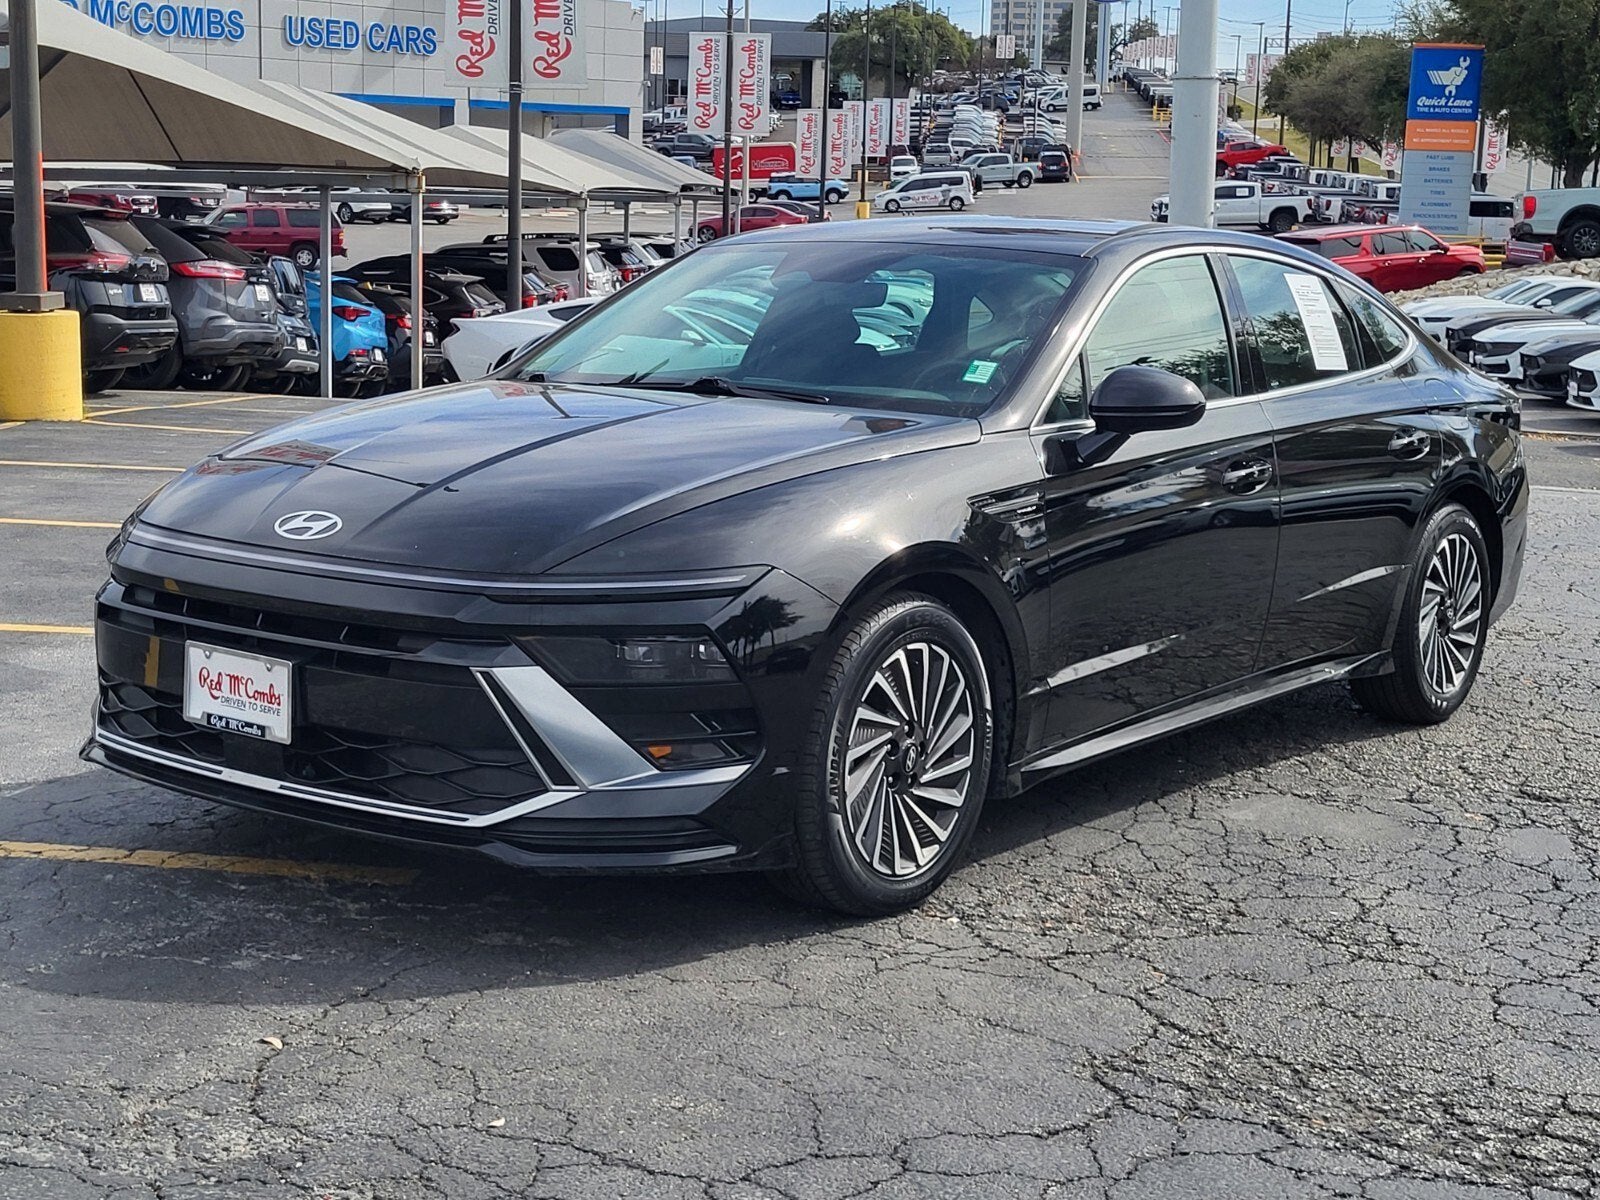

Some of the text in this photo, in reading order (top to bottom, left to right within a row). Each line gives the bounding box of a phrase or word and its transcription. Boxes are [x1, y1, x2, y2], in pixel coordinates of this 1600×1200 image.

[287, 15, 438, 56] USED CARS
[456, 29, 496, 78] Red
[533, 30, 572, 79] Red
[694, 38, 717, 129] Red McCombs
[713, 63, 720, 74] TO
[738, 39, 761, 130] Red McCombs
[757, 64, 764, 76] TO
[869, 104, 879, 137] McCombs
[1416, 96, 1473, 107] Quick Lane
[800, 113, 815, 174] Red McCombs
[830, 113, 846, 175] Red McCombs
[1485, 152, 1501, 170] Red
[199, 666, 281, 706] Red McCombs
[210, 714, 262, 736] Red McCombs
[221, 696, 281, 717] DRIVEN TO SERVE
